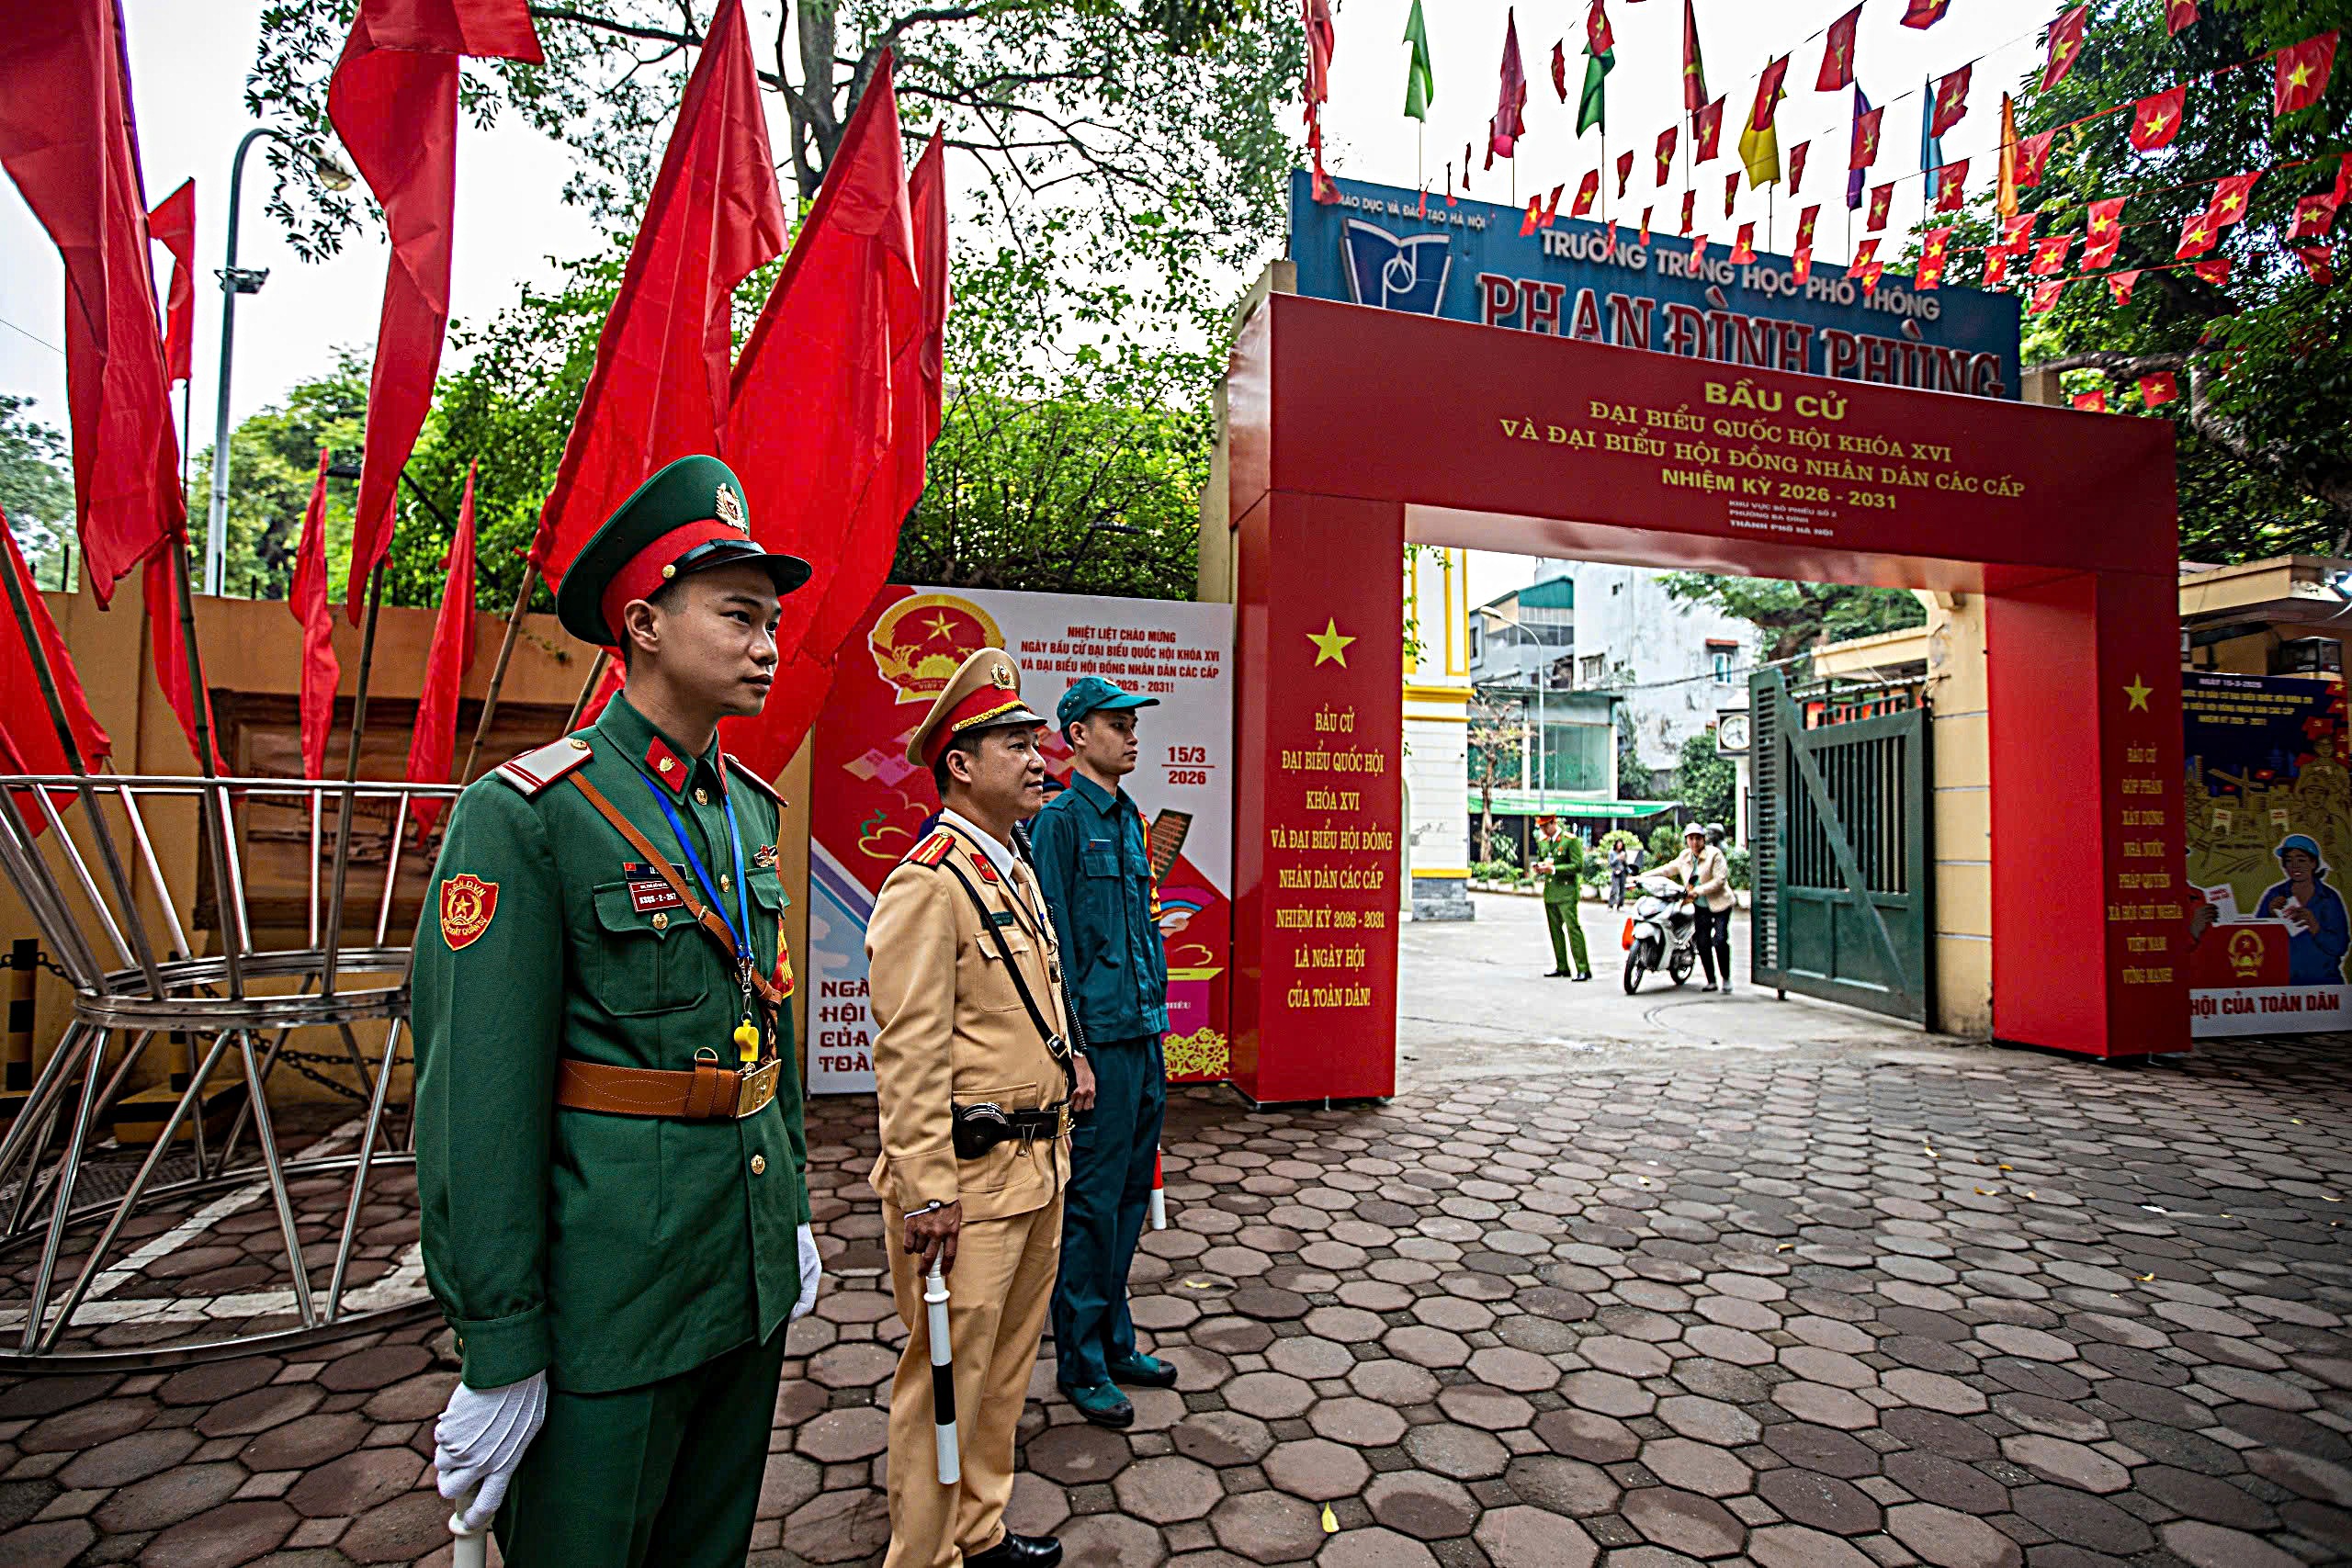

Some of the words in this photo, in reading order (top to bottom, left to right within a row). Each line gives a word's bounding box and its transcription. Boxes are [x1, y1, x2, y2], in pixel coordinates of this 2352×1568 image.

[1362, 197, 1384, 213] DỤC
[1387, 199, 1399, 215] VÀ
[1427, 209, 1446, 223] TẠO
[1450, 210, 1464, 225] HÀ
[1467, 214, 1486, 230] NỘI
[1541, 228, 1647, 270] TRƯỜNG
[1742, 265, 1798, 299] HỌC
[1477, 272, 1654, 351] PHAN
[1664, 285, 1815, 375] ĐÌNH
[1822, 319, 2006, 399] PHÙNG
[1704, 378, 1782, 412] BẦU
[1795, 389, 1848, 421] CỬ
[1589, 400, 1638, 425] ĐẠI
[1645, 403, 1706, 433] BIỂU
[1713, 417, 1782, 443] QUỐC
[1787, 427, 1831, 452] HỘI
[1838, 434, 1905, 458] KHÓA
[1911, 443, 1952, 463] XVI
[1499, 417, 1540, 441] VÀ
[1547, 425, 1596, 450] ĐẠI
[1604, 426, 1667, 457] BIỂU
[1674, 440, 1721, 467] HỘI
[1727, 444, 1799, 474] ĐỒNG
[1805, 458, 1874, 482] NHÂN
[1881, 464, 1929, 488] DÂN
[1935, 471, 1978, 493] CÁC
[1983, 475, 2025, 498] CẤP
[1662, 468, 1736, 494] NHIỆM
[1742, 476, 1772, 496] KỲ
[1779, 482, 1830, 502] 2026
[1849, 491, 1896, 510] 2031
[1068, 626, 1095, 640] NHIỆT
[1098, 626, 1117, 641] LIỆT
[1120, 627, 1145, 641] CHÀO
[1148, 628, 1176, 643] MỪNG
[1021, 639, 1047, 653] NGÀY
[1072, 640, 1087, 655] CỬ
[1088, 644, 1104, 658] ĐẠI
[1107, 641, 1128, 658] BIỂU
[1131, 644, 1156, 659] QUỐC
[1159, 647, 1174, 661] HỘI
[1177, 647, 1202, 660] KHÓA
[1204, 650, 1220, 661] XVI
[1021, 657, 1033, 670] VÀ
[1036, 660, 1053, 672] ĐẠI
[1056, 657, 1078, 671] BIỂU
[1080, 660, 1096, 675] HỘI
[1128, 662, 1154, 675] NHÂN
[1158, 663, 1176, 677] DÂN
[1179, 664, 1197, 678] CÁC
[1200, 664, 1219, 678] CẤP
[1148, 681, 1174, 693] 2031!
[1315, 703, 1337, 732] BẦU
[1340, 705, 1355, 732] CỬ
[1168, 747, 1205, 762] 15/3
[1282, 750, 1302, 774] ĐẠI
[1305, 739, 1330, 772] BIỂU
[1332, 744, 1363, 773] QUỐC
[1364, 749, 1384, 776] HỘI
[1169, 771, 1206, 784] 2026
[1306, 785, 1338, 810] KHÓA
[1340, 792, 1360, 811] XVI
[1271, 824, 1287, 848] VÀ
[1289, 830, 1309, 852] ĐẠI
[1312, 818, 1338, 850] BIỂU
[1340, 826, 1360, 854] HỘI
[1363, 822, 1392, 851] ĐỒNG
[1279, 863, 1311, 888] NHÂN
[1314, 863, 1338, 888] DÂN
[1340, 864, 1362, 889] CÁC
[1363, 862, 1384, 889] CẤP
[1276, 904, 1314, 932] NHIỆM
[1316, 904, 1332, 928] KỲ
[1334, 910, 1356, 928] 2026
[1363, 910, 1385, 928] 2031
[1295, 942, 1309, 967] LÀ
[1312, 942, 1343, 967] NGÀY
[1345, 942, 1365, 972] HỘI
[821, 977, 870, 998] NGÀ
[1287, 979, 1310, 1008] CỦA
[1313, 982, 1343, 1008] TOÀN
[1345, 981, 1371, 1007] DÂN!
[819, 1003, 865, 1025] HỘI
[2189, 995, 2217, 1020] HỘI
[2222, 991, 2256, 1015] CỦA
[2259, 992, 2301, 1012] TOÀN
[2306, 991, 2339, 1010] DÂN
[820, 1027, 870, 1047] CỦA
